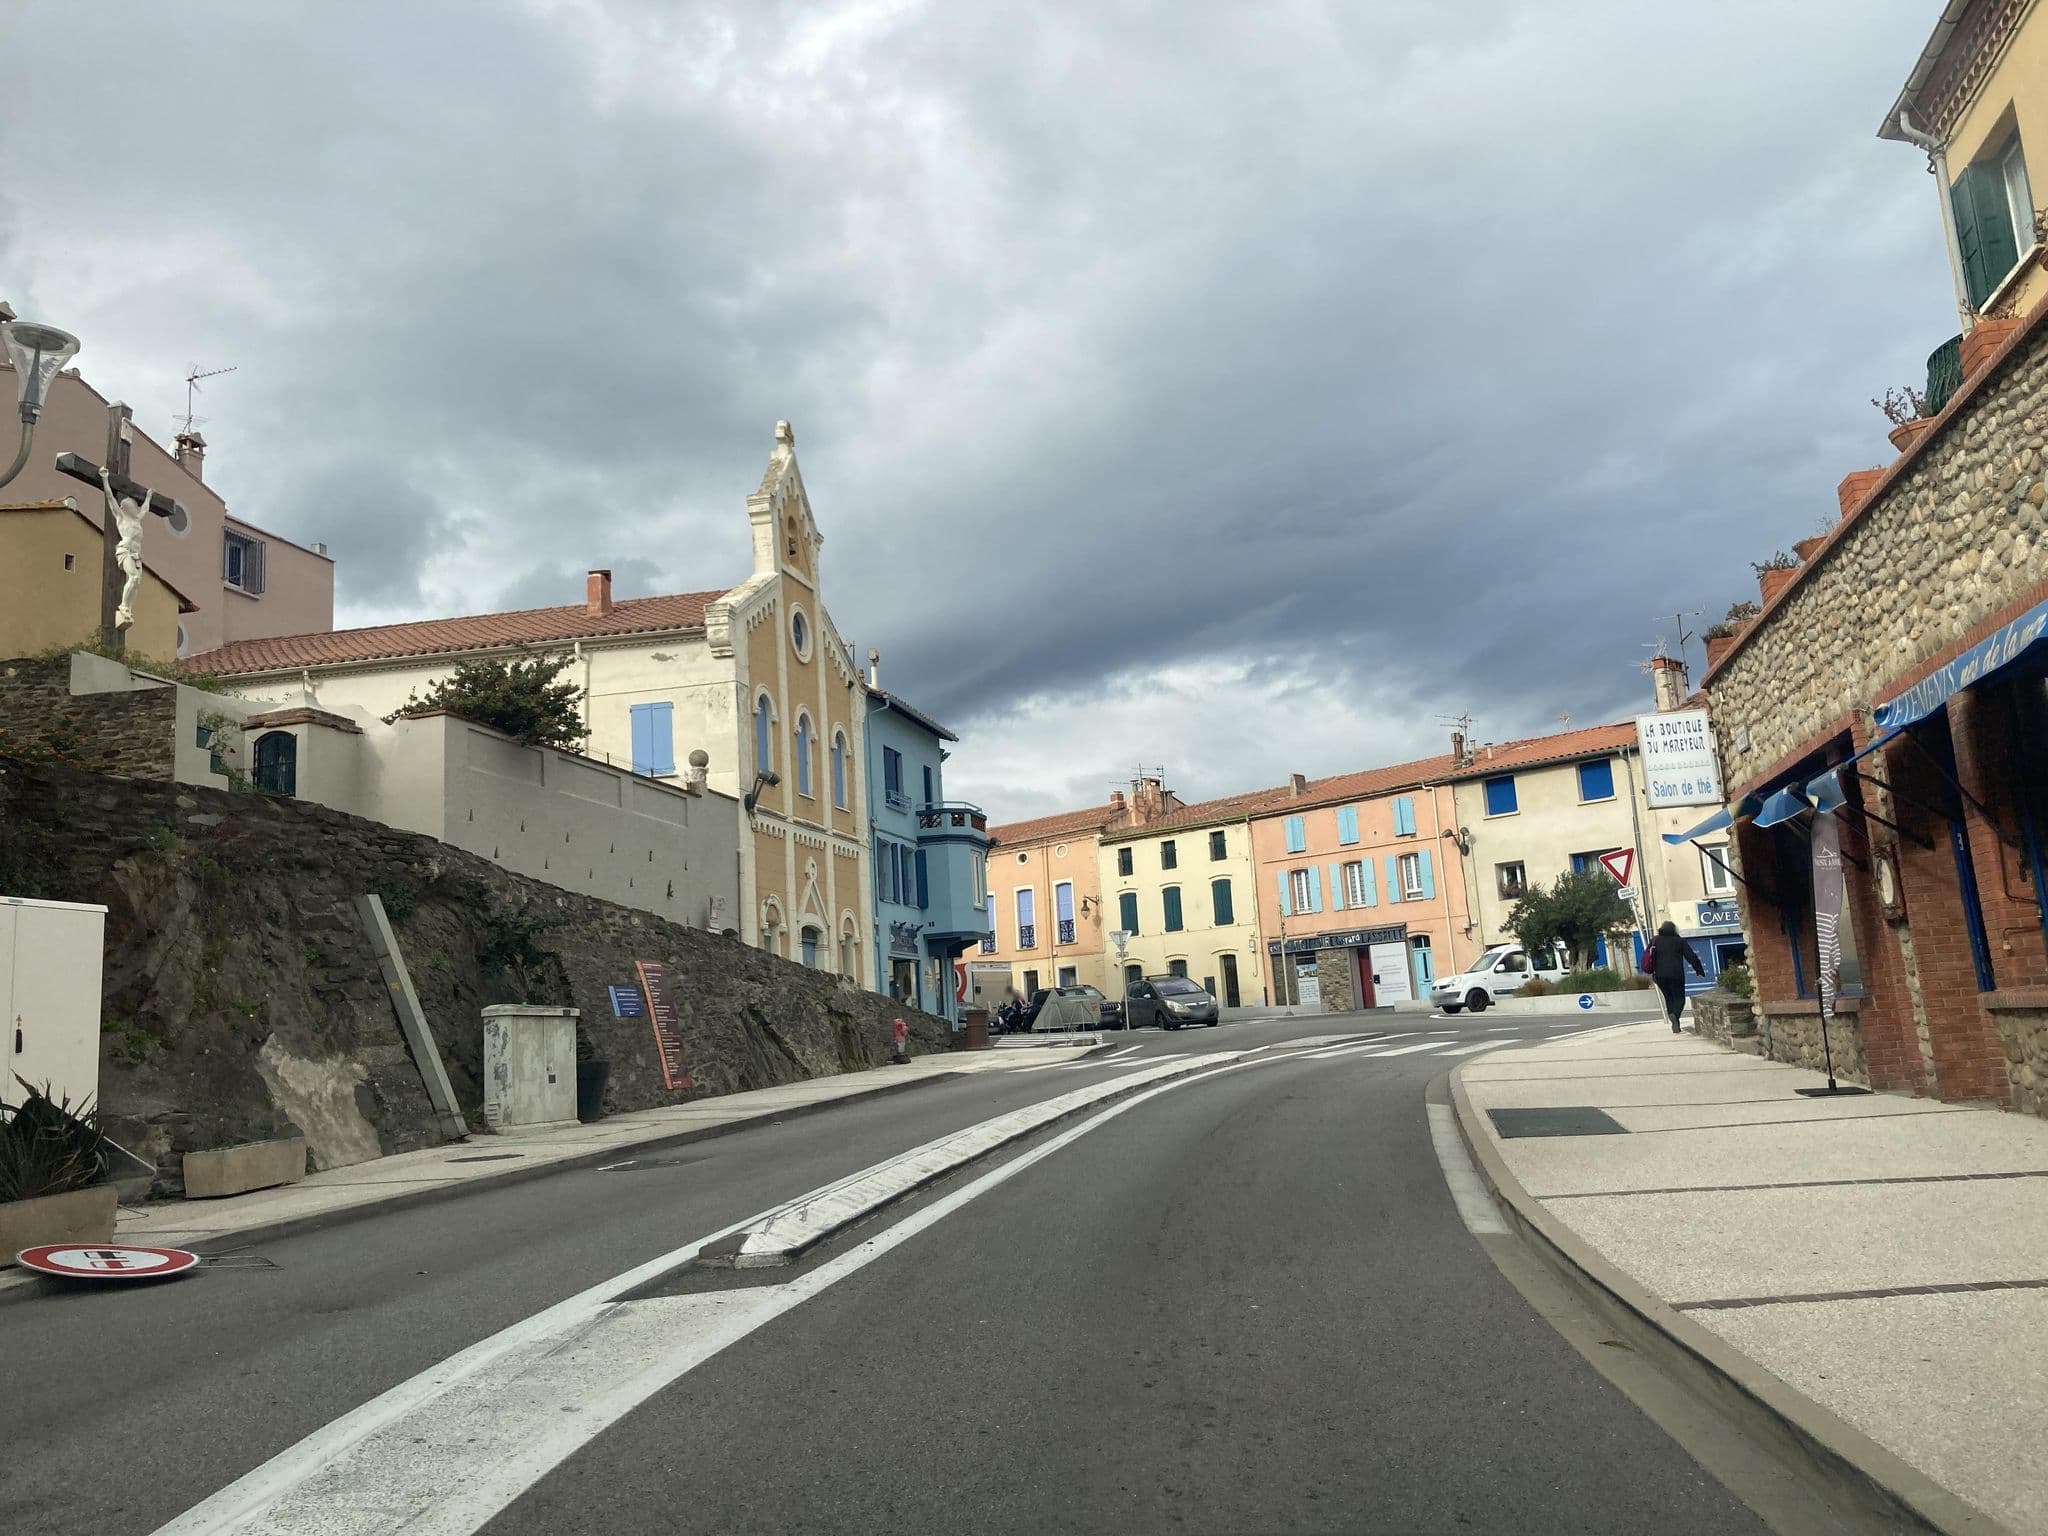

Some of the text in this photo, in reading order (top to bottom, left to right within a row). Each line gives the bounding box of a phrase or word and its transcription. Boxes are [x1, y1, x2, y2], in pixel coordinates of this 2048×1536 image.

[1983, 634, 2000, 672] de
[2003, 622, 2018, 662] la
[1645, 719, 1703, 737] LA BOUTIQUE
[1647, 736, 1706, 753] DU MAREYEUR
[1652, 776, 1712, 798] Salon de thé
[1700, 911, 1731, 925] CAVE
